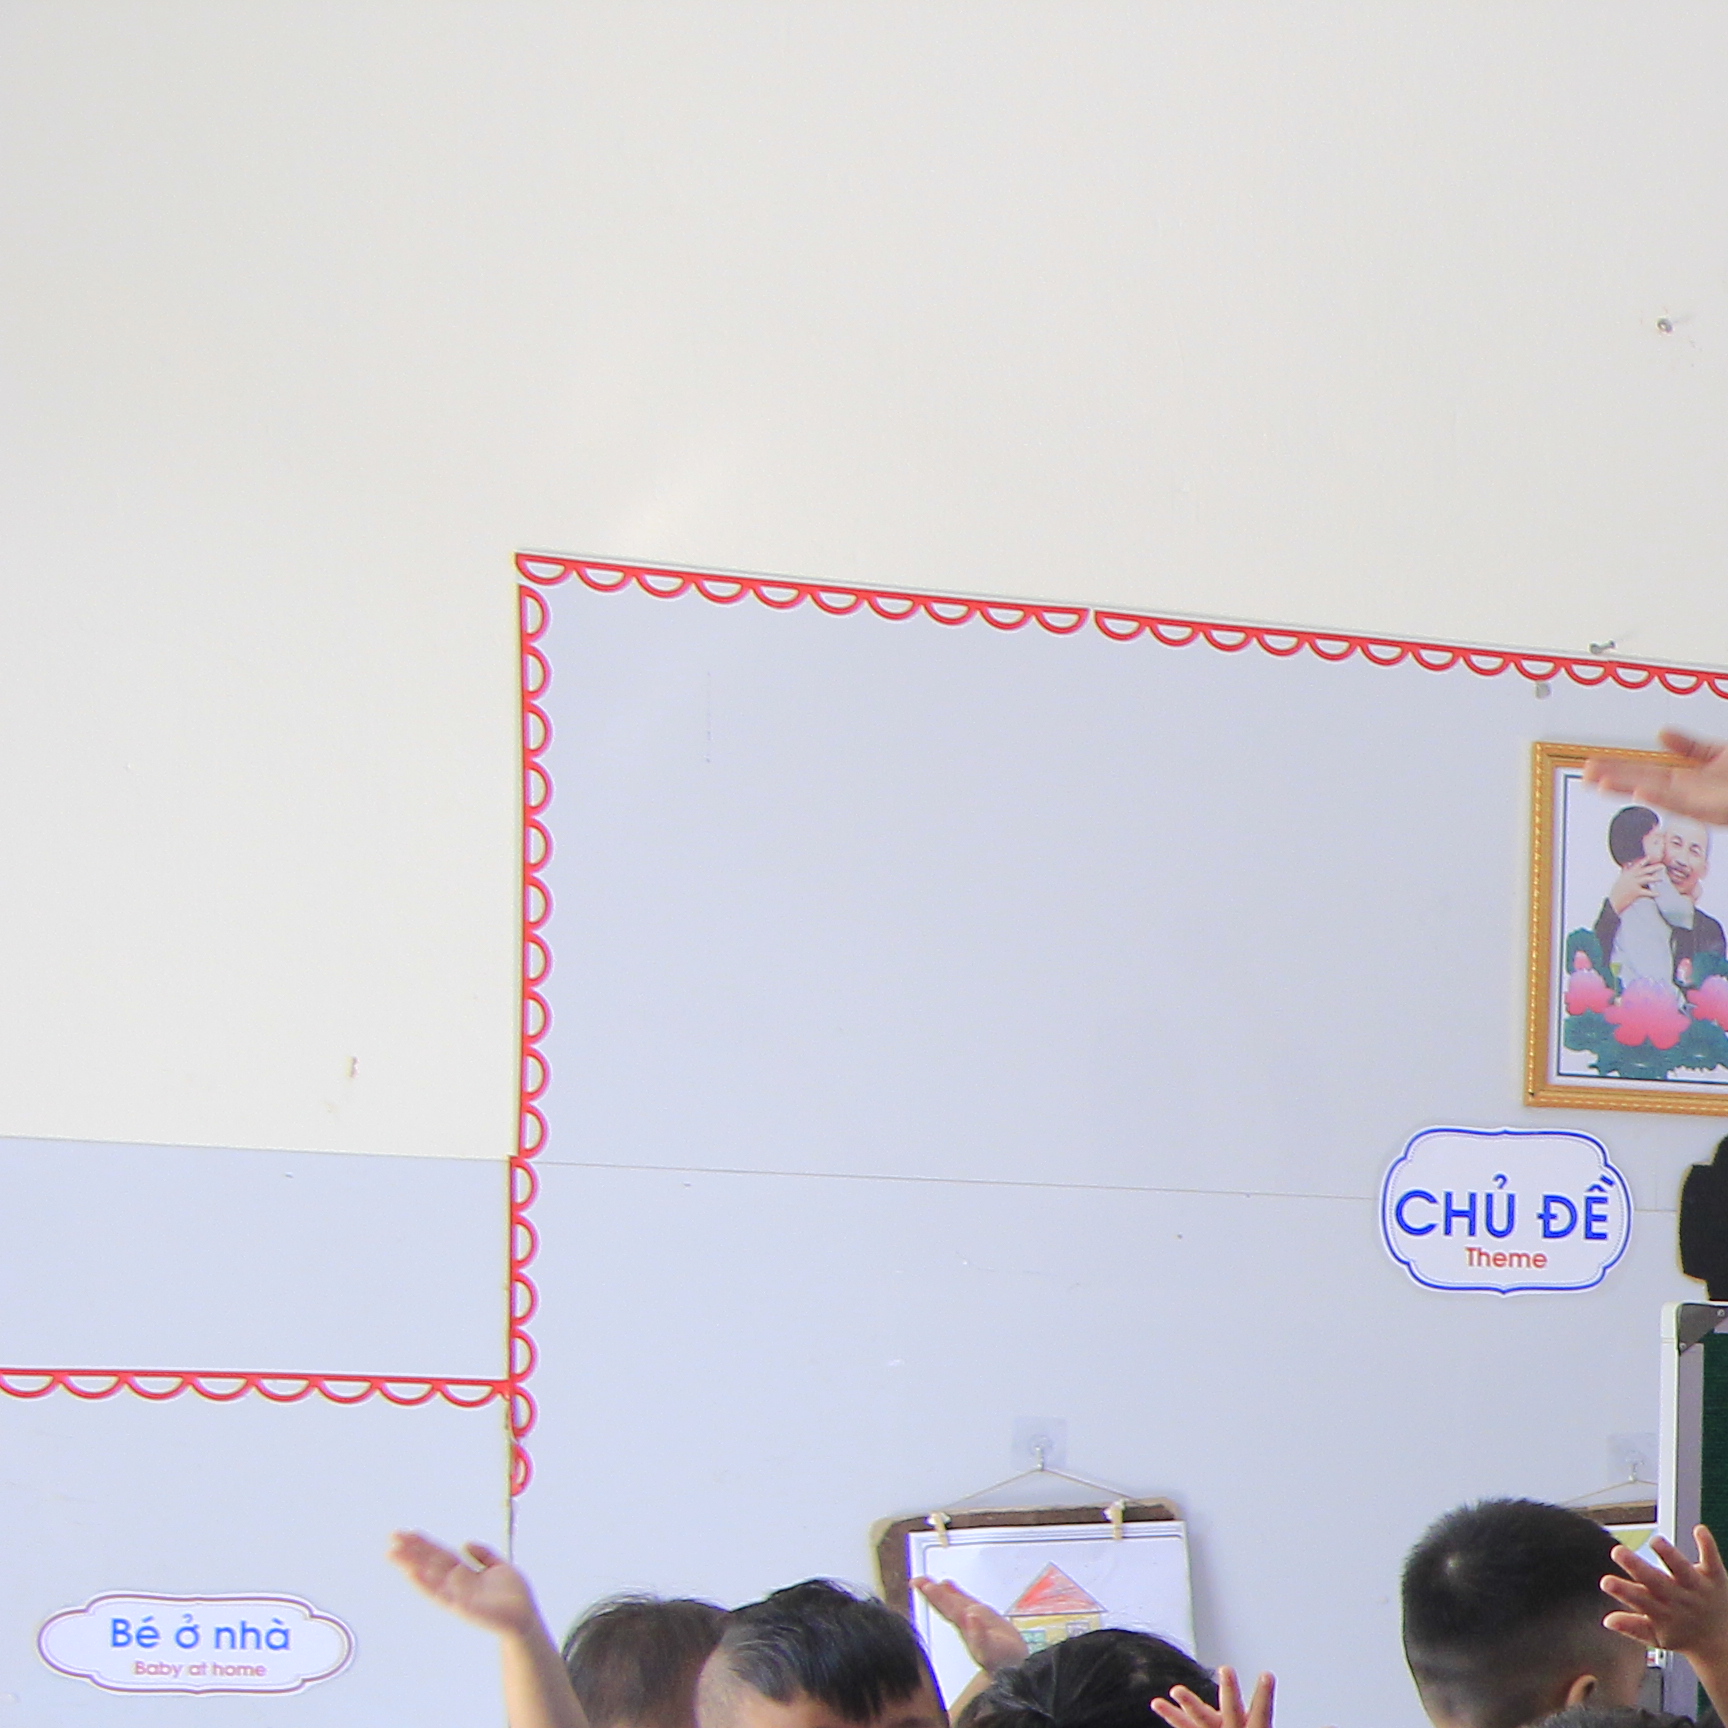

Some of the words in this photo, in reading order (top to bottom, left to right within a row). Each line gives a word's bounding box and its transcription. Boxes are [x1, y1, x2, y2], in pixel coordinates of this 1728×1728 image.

[1394, 1174, 1515, 1239] CHỦ
[1537, 1174, 1616, 1241] ĐỀ
[1465, 1247, 1547, 1269] Theme
[110, 1616, 161, 1648] Bé
[174, 1613, 200, 1650] ở
[214, 1618, 291, 1651] nhà
[134, 1660, 183, 1679] Baby
[189, 1662, 208, 1677] at
[212, 1662, 267, 1678] home
